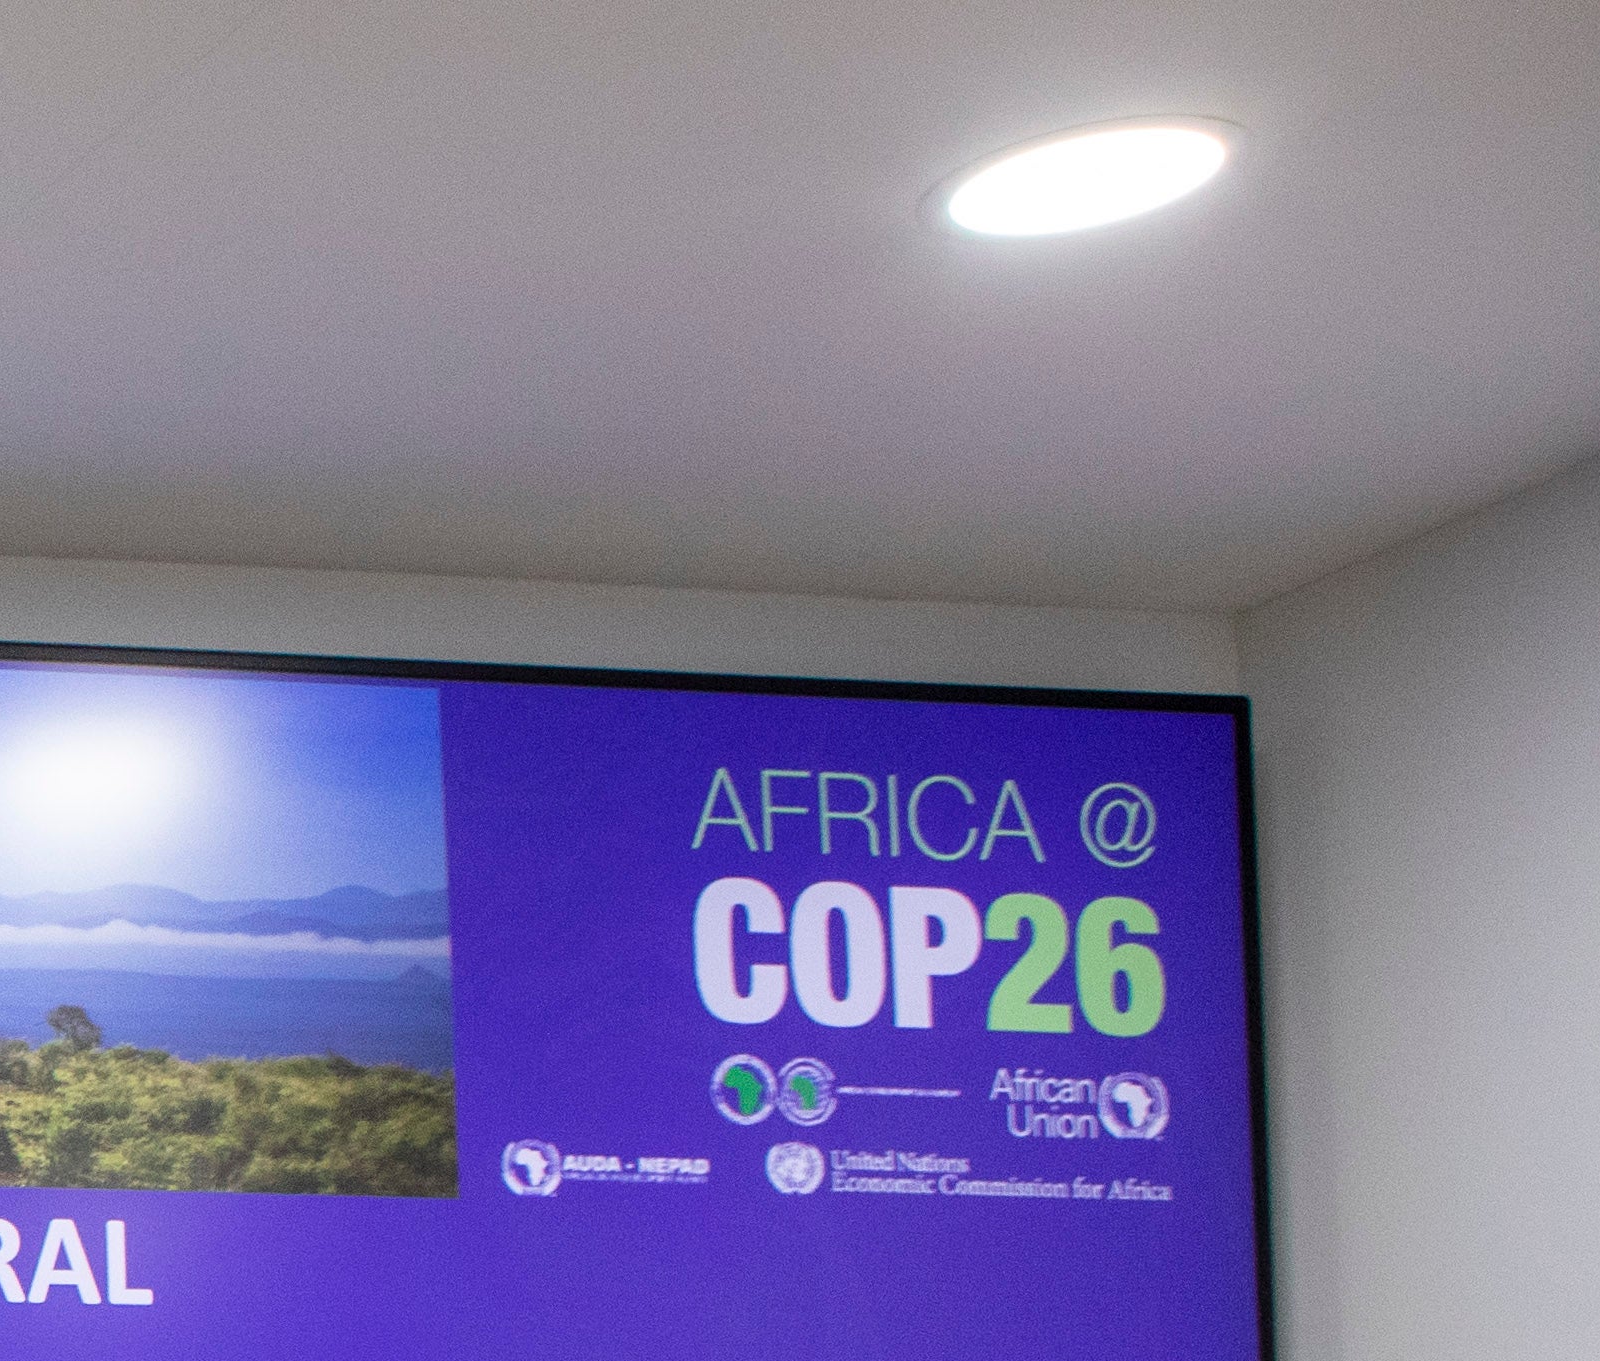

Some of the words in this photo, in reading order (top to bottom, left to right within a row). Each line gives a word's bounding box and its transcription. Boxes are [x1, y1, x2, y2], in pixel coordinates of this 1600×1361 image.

[691, 767, 1047, 863] AFRICA
[1080, 782, 1157, 868] @
[693, 876, 1167, 1037] COP26
[989, 1068, 1098, 1104] African
[1006, 1107, 1098, 1140] Union
[831, 1173, 936, 1195] Economic
[938, 1175, 1068, 1198] Commission
[1106, 1179, 1172, 1202] Africa
